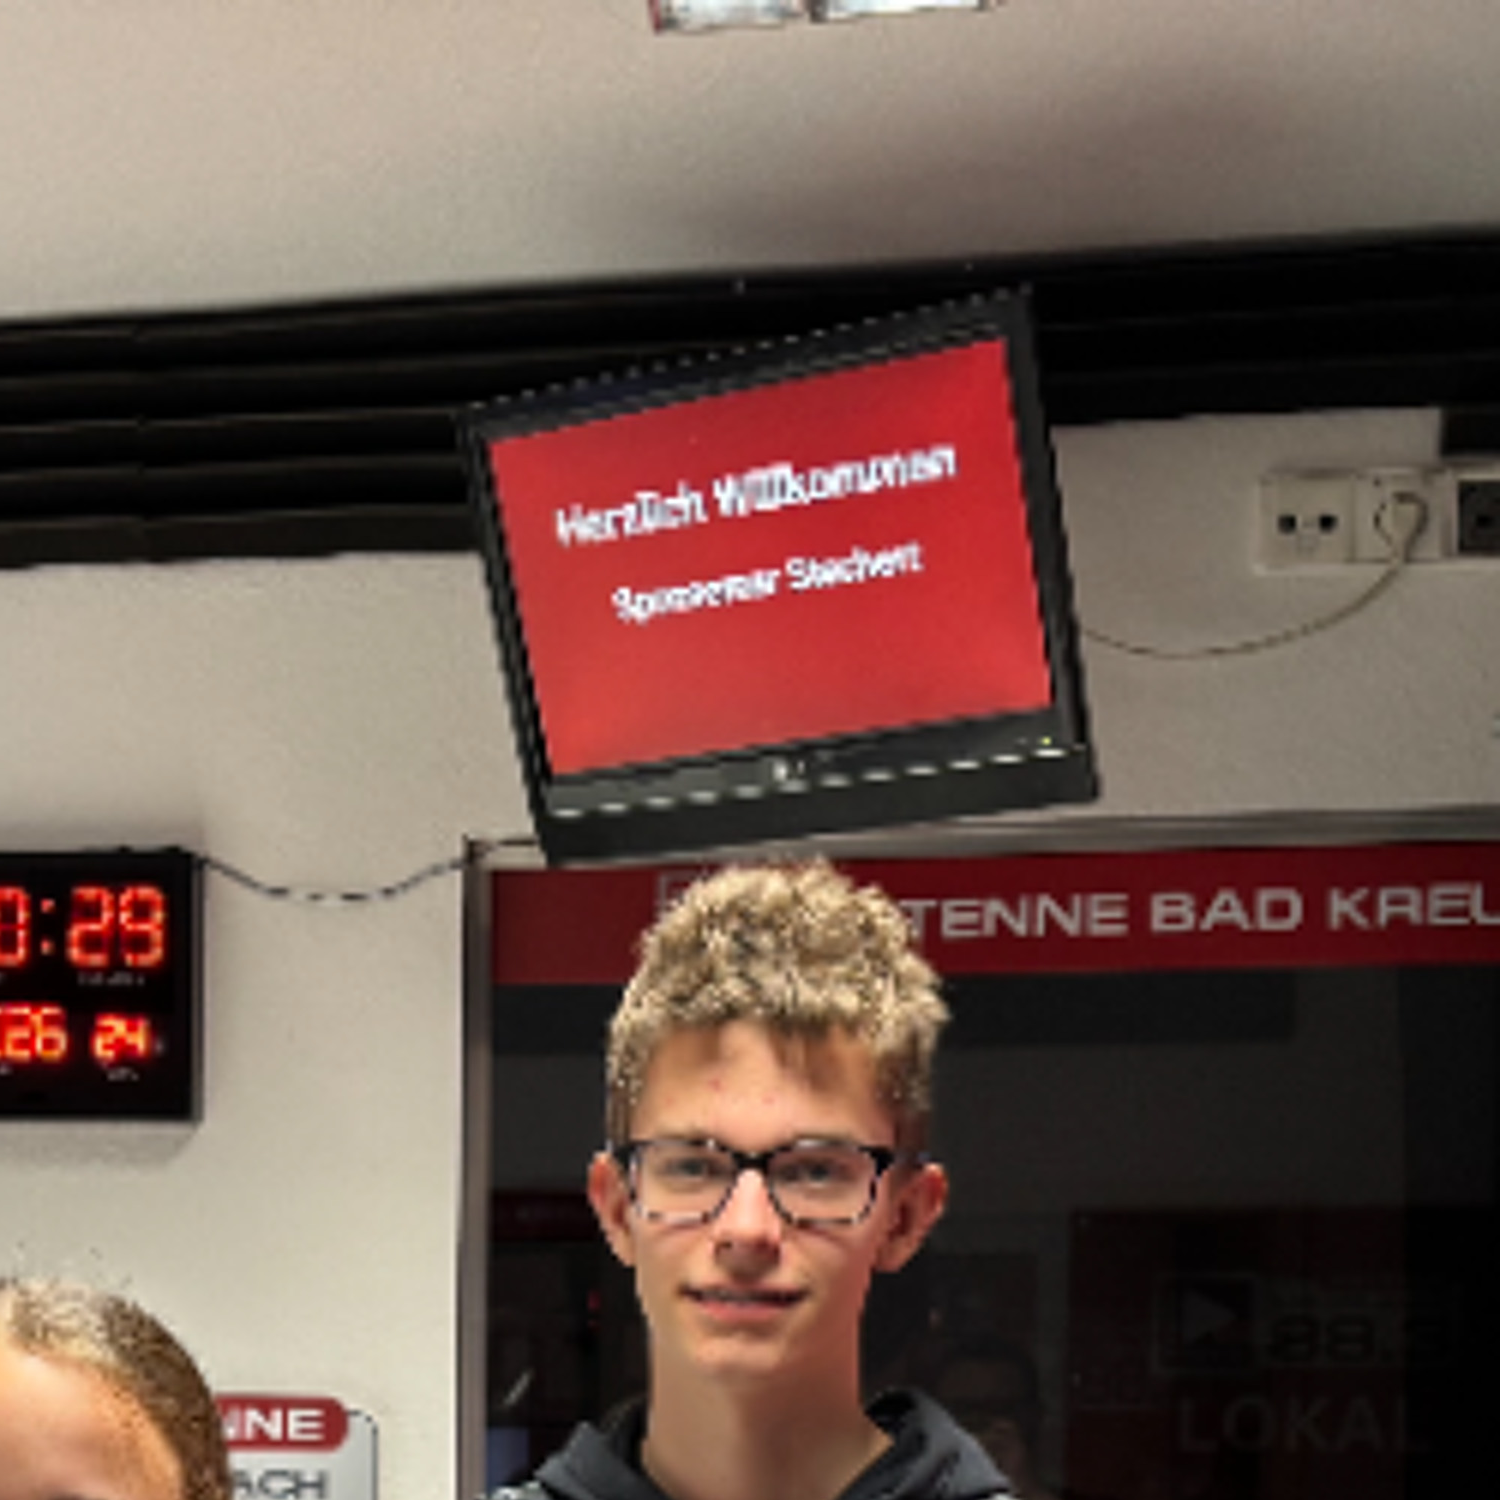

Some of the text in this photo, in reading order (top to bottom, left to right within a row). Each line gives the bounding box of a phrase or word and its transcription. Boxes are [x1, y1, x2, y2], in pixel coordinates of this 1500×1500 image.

[555, 443, 957, 547] Herzlich Willkommen
[1150, 886, 1304, 933] BAD
